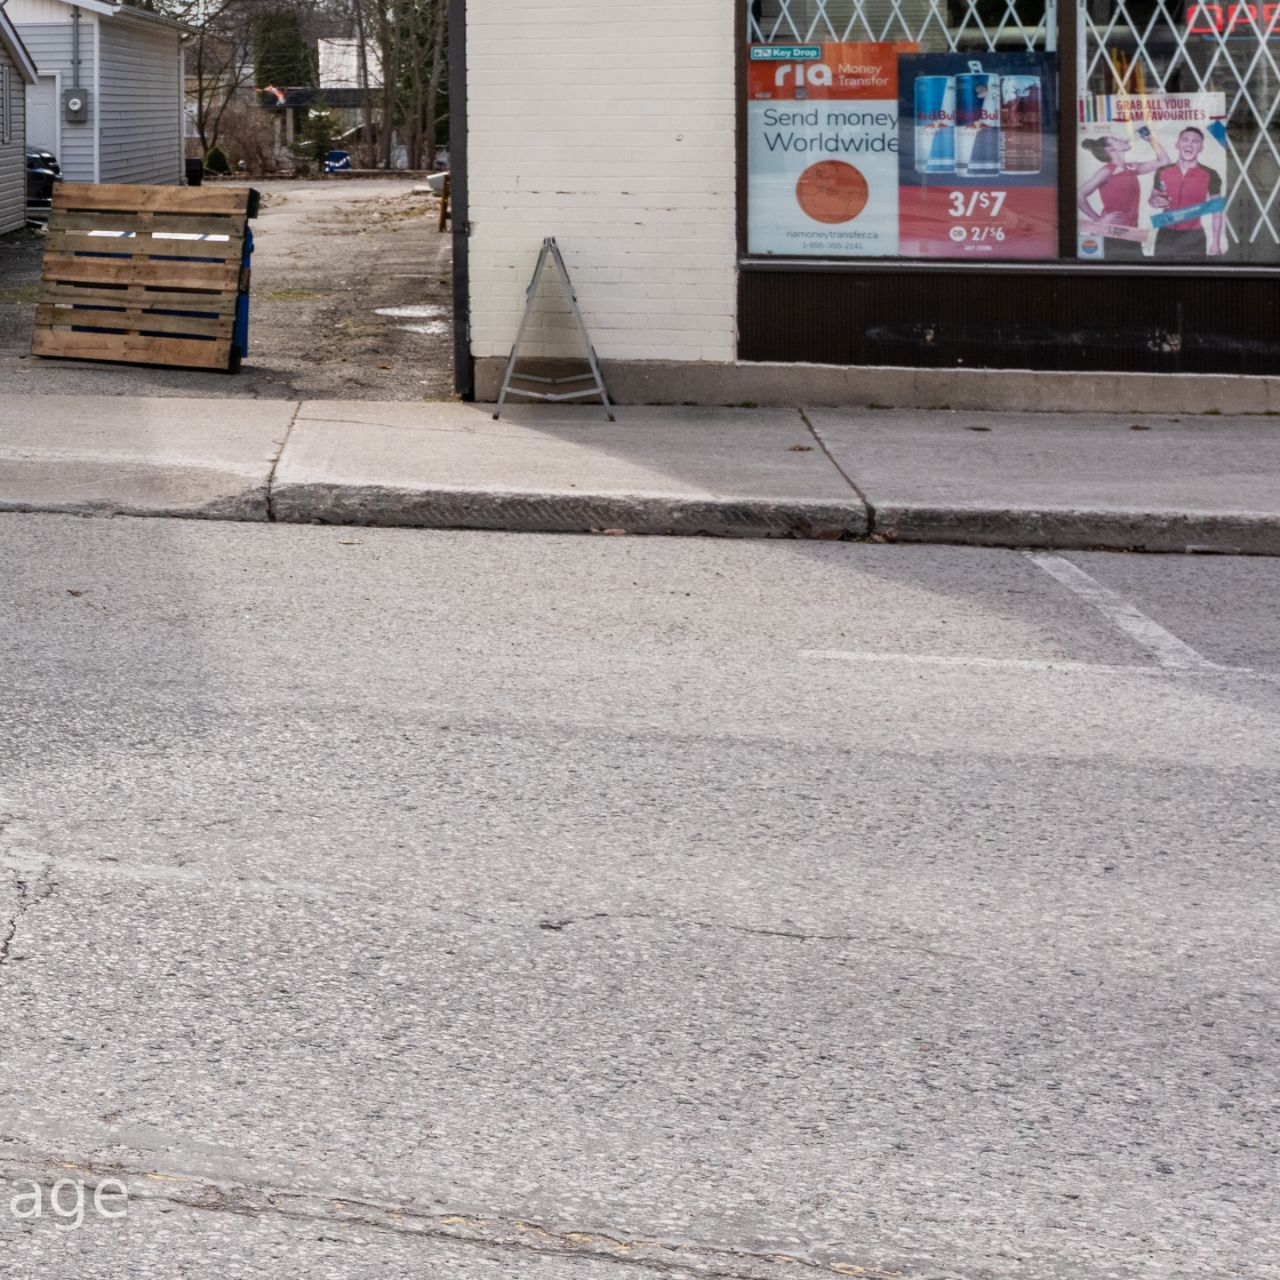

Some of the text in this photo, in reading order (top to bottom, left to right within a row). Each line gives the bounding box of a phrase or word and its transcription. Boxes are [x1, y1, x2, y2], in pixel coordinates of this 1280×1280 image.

[773, 48, 817, 57] Key Drop
[775, 64, 832, 86] ria
[838, 64, 881, 74] Money
[838, 76, 888, 86] Transfer
[1116, 99, 1191, 111] GRAB ALL YOUR
[763, 108, 899, 129] Send money
[1117, 109, 1206, 121] TEAM FAVOURITES
[764, 132, 899, 152] Worldwide
[948, 191, 1007, 217] 3/$7
[786, 230, 878, 240] riamoneytransfer.ca
[971, 226, 1005, 241] 2/$6
